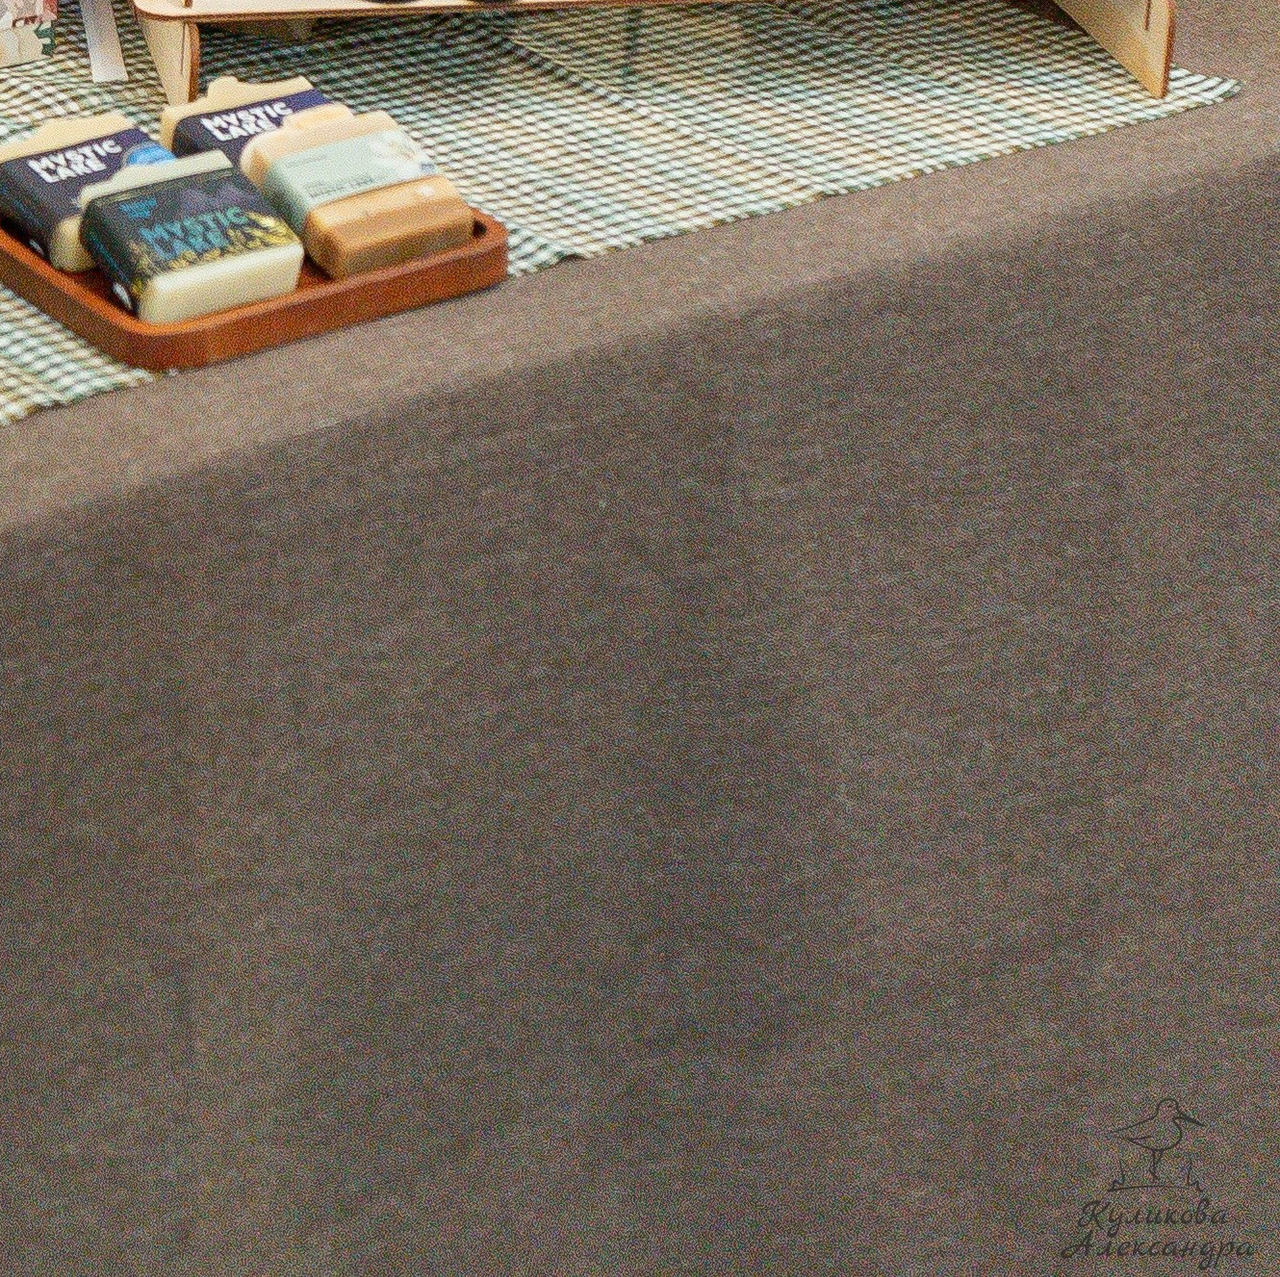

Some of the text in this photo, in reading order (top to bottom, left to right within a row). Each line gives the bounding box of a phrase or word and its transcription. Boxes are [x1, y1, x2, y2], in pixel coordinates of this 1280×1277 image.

[201, 101, 293, 131] MYSTIC
[214, 117, 283, 142] LAKE
[28, 138, 123, 169] MYSTIC
[42, 157, 107, 184] LAKE
[137, 205, 249, 245] MYSTIC
